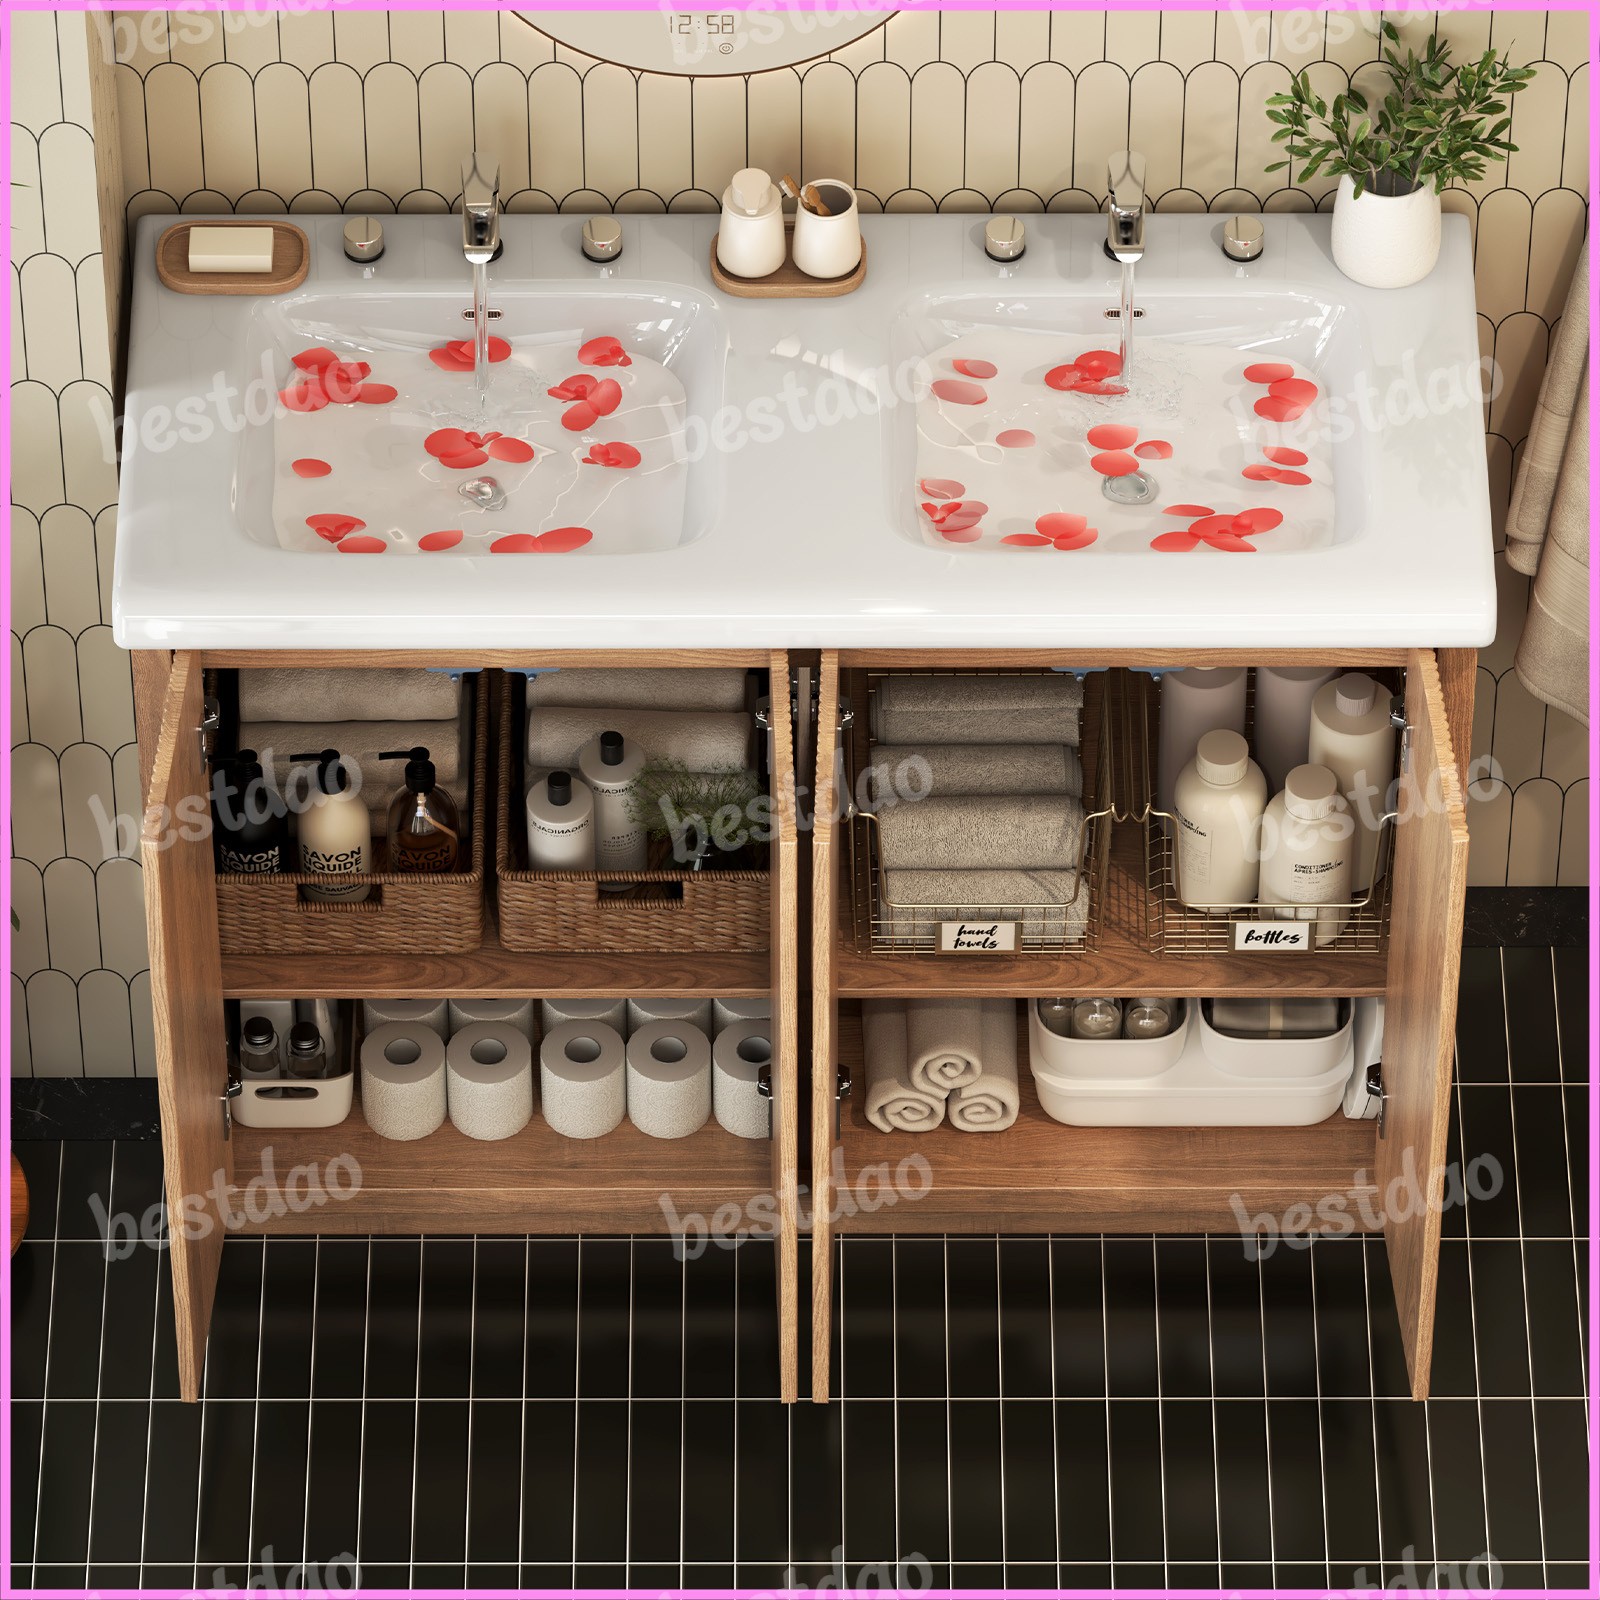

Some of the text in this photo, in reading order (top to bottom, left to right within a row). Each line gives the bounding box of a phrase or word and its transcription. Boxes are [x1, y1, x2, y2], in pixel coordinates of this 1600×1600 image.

[669, 14, 734, 34] 12:58
[220, 844, 279, 863] SAVON
[303, 844, 361, 863] SAVON
[221, 854, 280, 873] LIQUIDE
[303, 854, 362, 872] LIQUIDE
[957, 924, 998, 937] hand
[1244, 929, 1304, 944] bottles
[953, 936, 1000, 950] towels
